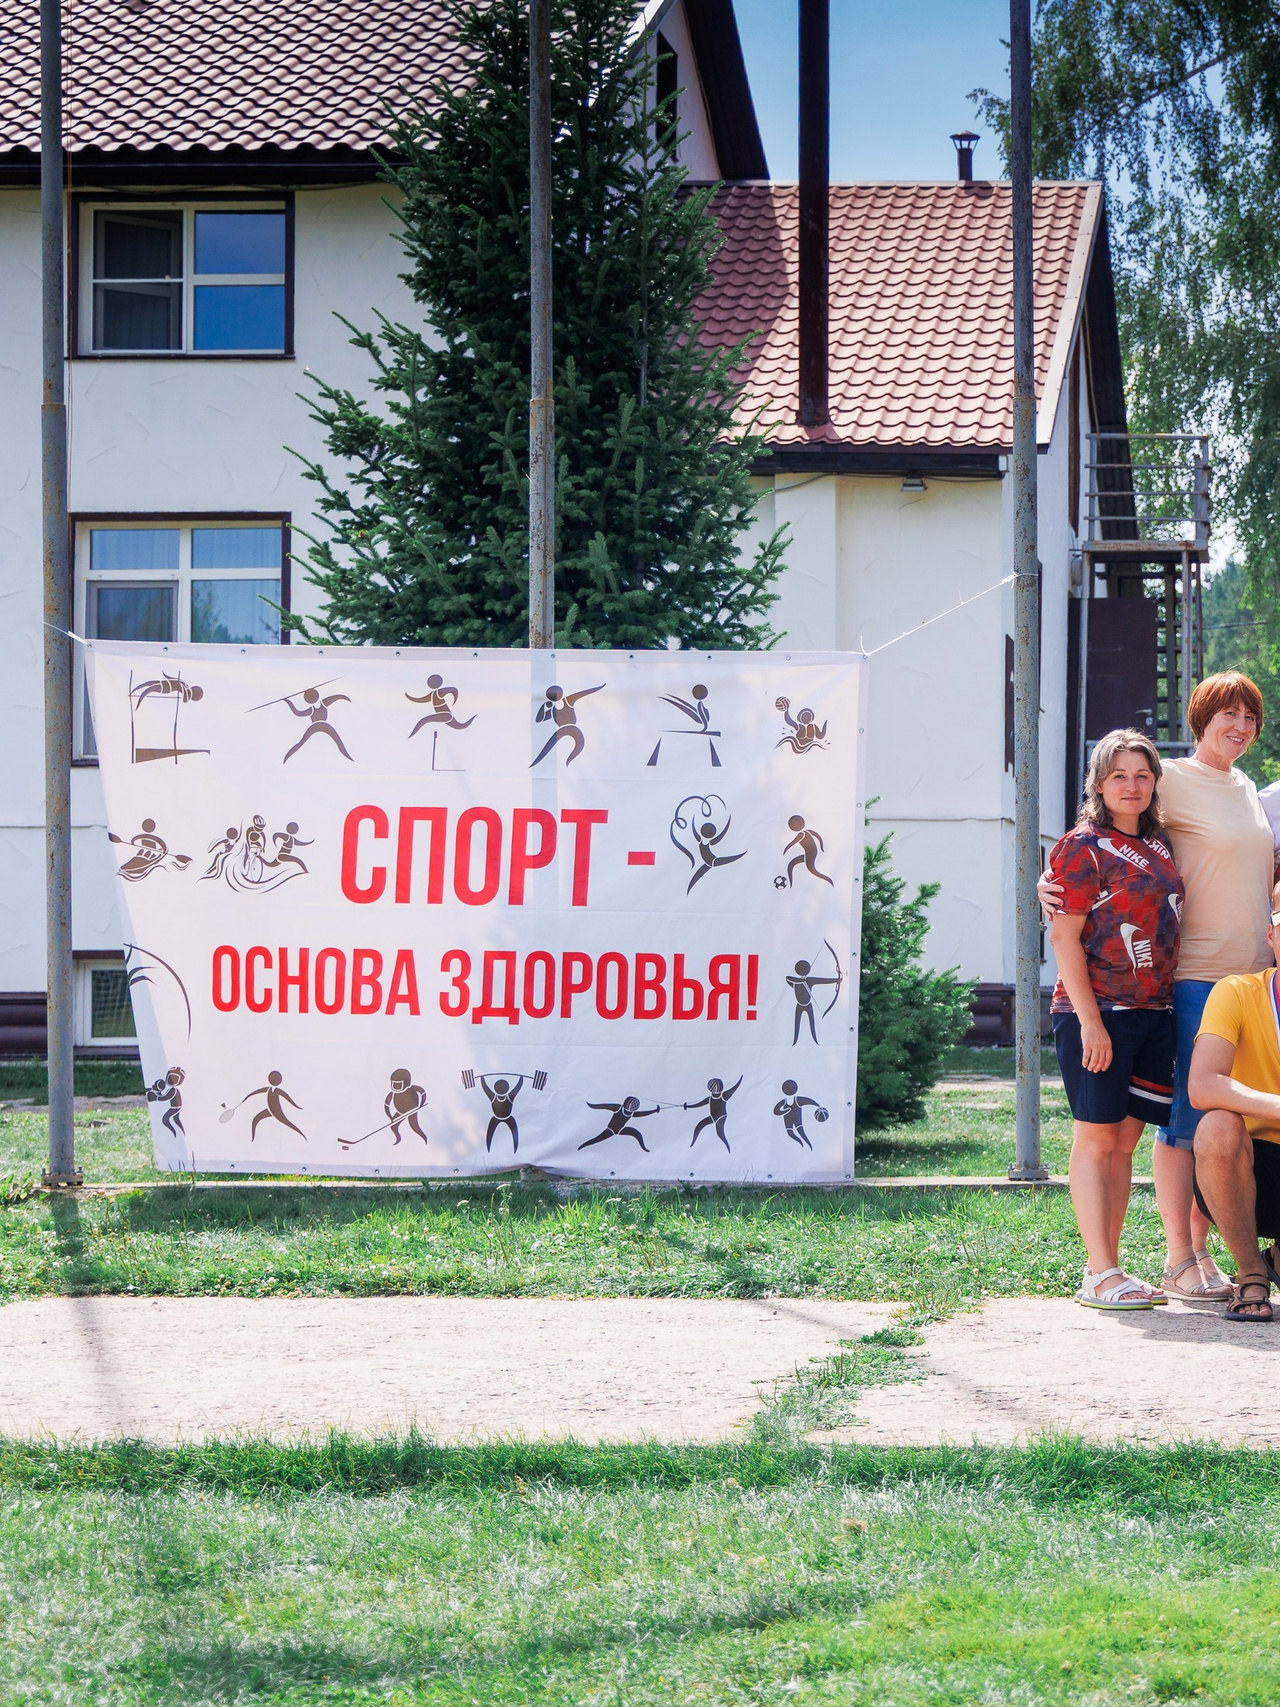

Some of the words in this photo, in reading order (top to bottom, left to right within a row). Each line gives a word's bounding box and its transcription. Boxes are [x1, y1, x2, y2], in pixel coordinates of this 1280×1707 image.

[341, 805, 609, 907] СПОРТ
[627, 851, 656, 866] -
[1119, 843, 1150, 868] NIKE
[1133, 939, 1154, 969] NIKE
[212, 944, 421, 1016] ОСНОВА
[439, 949, 759, 1025] ЗДОРОВЬЯ!
